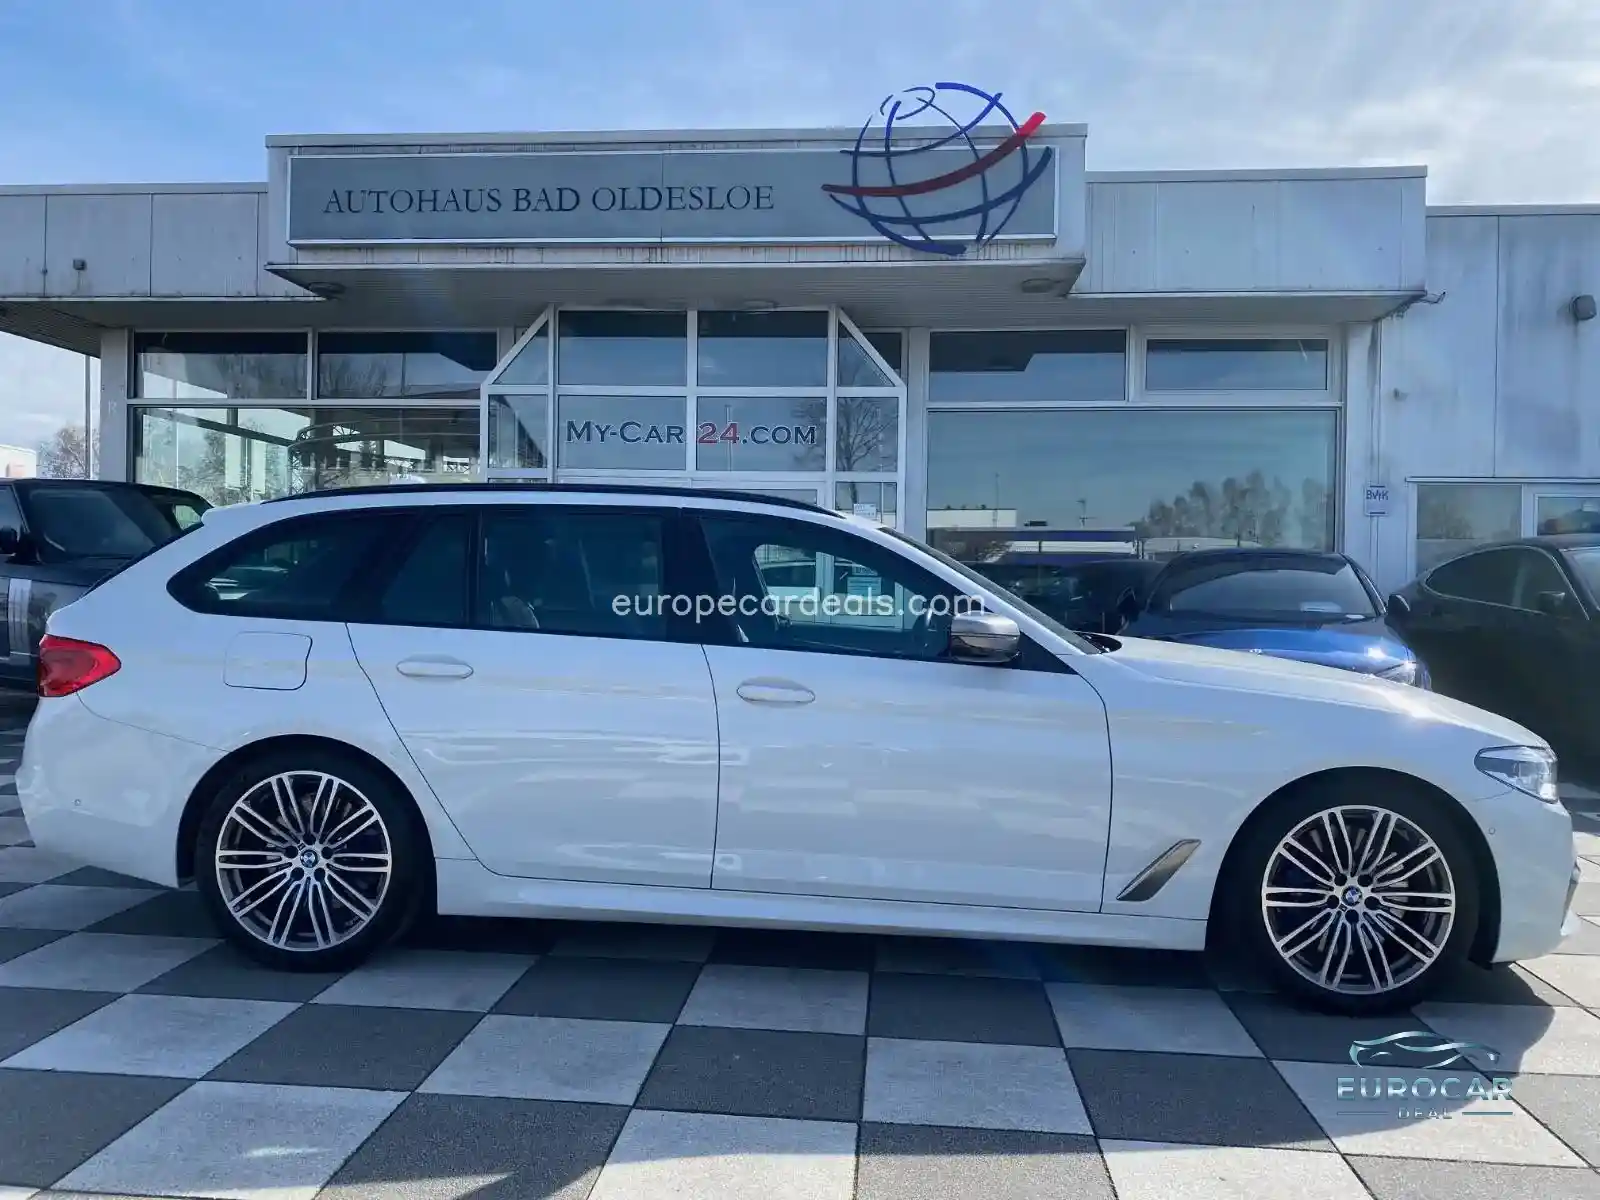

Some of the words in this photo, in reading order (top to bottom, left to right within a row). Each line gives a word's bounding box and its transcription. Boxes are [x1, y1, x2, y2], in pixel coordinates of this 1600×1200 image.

[323, 188, 502, 213] AUTOHAUS
[512, 187, 580, 212] BAD
[592, 185, 774, 211] OLDESLOE
